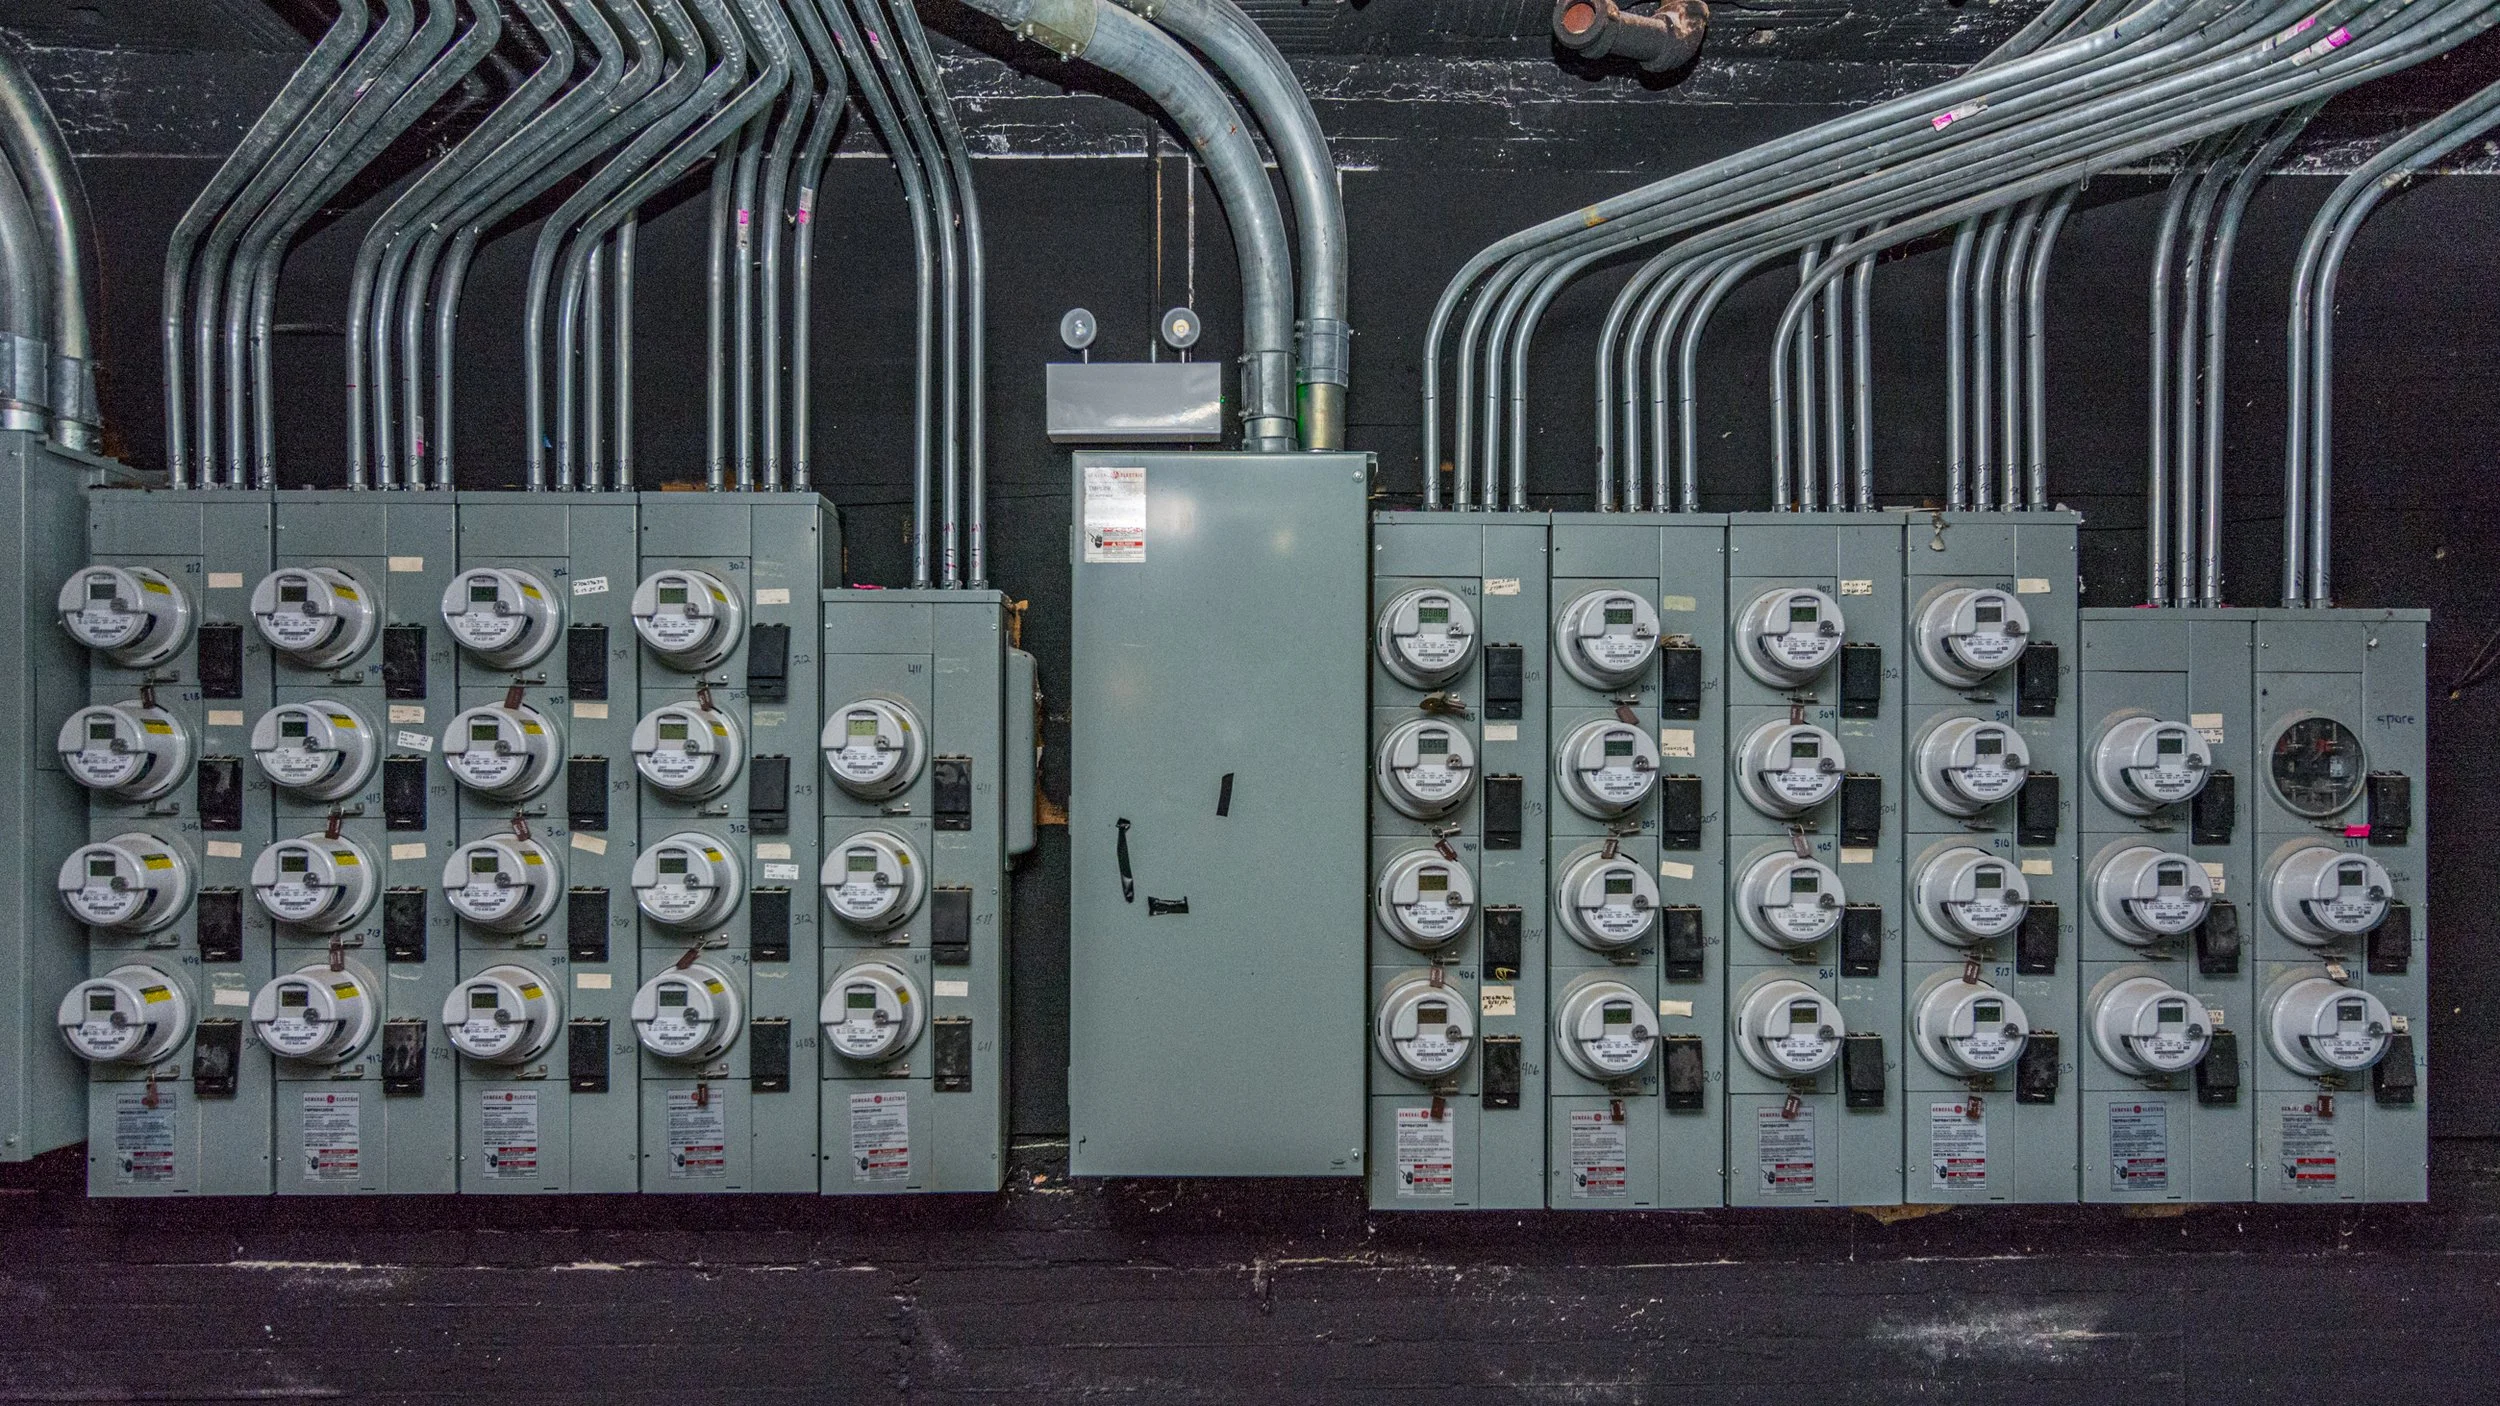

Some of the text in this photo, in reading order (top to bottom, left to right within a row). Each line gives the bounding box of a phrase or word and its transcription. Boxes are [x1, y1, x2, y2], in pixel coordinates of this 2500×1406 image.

[186, 562, 201, 573] 212
[728, 562, 746, 570] 302
[1461, 585, 1478, 596] 401
[908, 663, 922, 674] 411
[1524, 672, 1540, 683] 401
[1819, 710, 1834, 719] 504
[1995, 710, 2009, 720] 509
[2376, 713, 2415, 729] spare
[366, 793, 381, 804] 413
[2060, 800, 2071, 813] 09
[182, 822, 199, 831] 306
[729, 824, 748, 833] 312
[1463, 842, 1478, 852] 404
[1817, 842, 1832, 851] 405
[1994, 838, 2009, 848] 510
[2344, 839, 2359, 848] 211
[794, 914, 814, 924] 312
[2411, 930, 2425, 941] 11
[182, 956, 199, 965] 408
[552, 957, 566, 966] 310
[1459, 970, 1475, 980] 406
[1995, 967, 2010, 977] 513
[2346, 969, 2359, 980] 311
[795, 1037, 816, 1049] 408
[431, 1046, 449, 1060] 412
[614, 1044, 634, 1055] 310
[366, 1055, 382, 1064] 412
[1521, 1061, 1540, 1076] 406
[1703, 1071, 1722, 1082] 210
